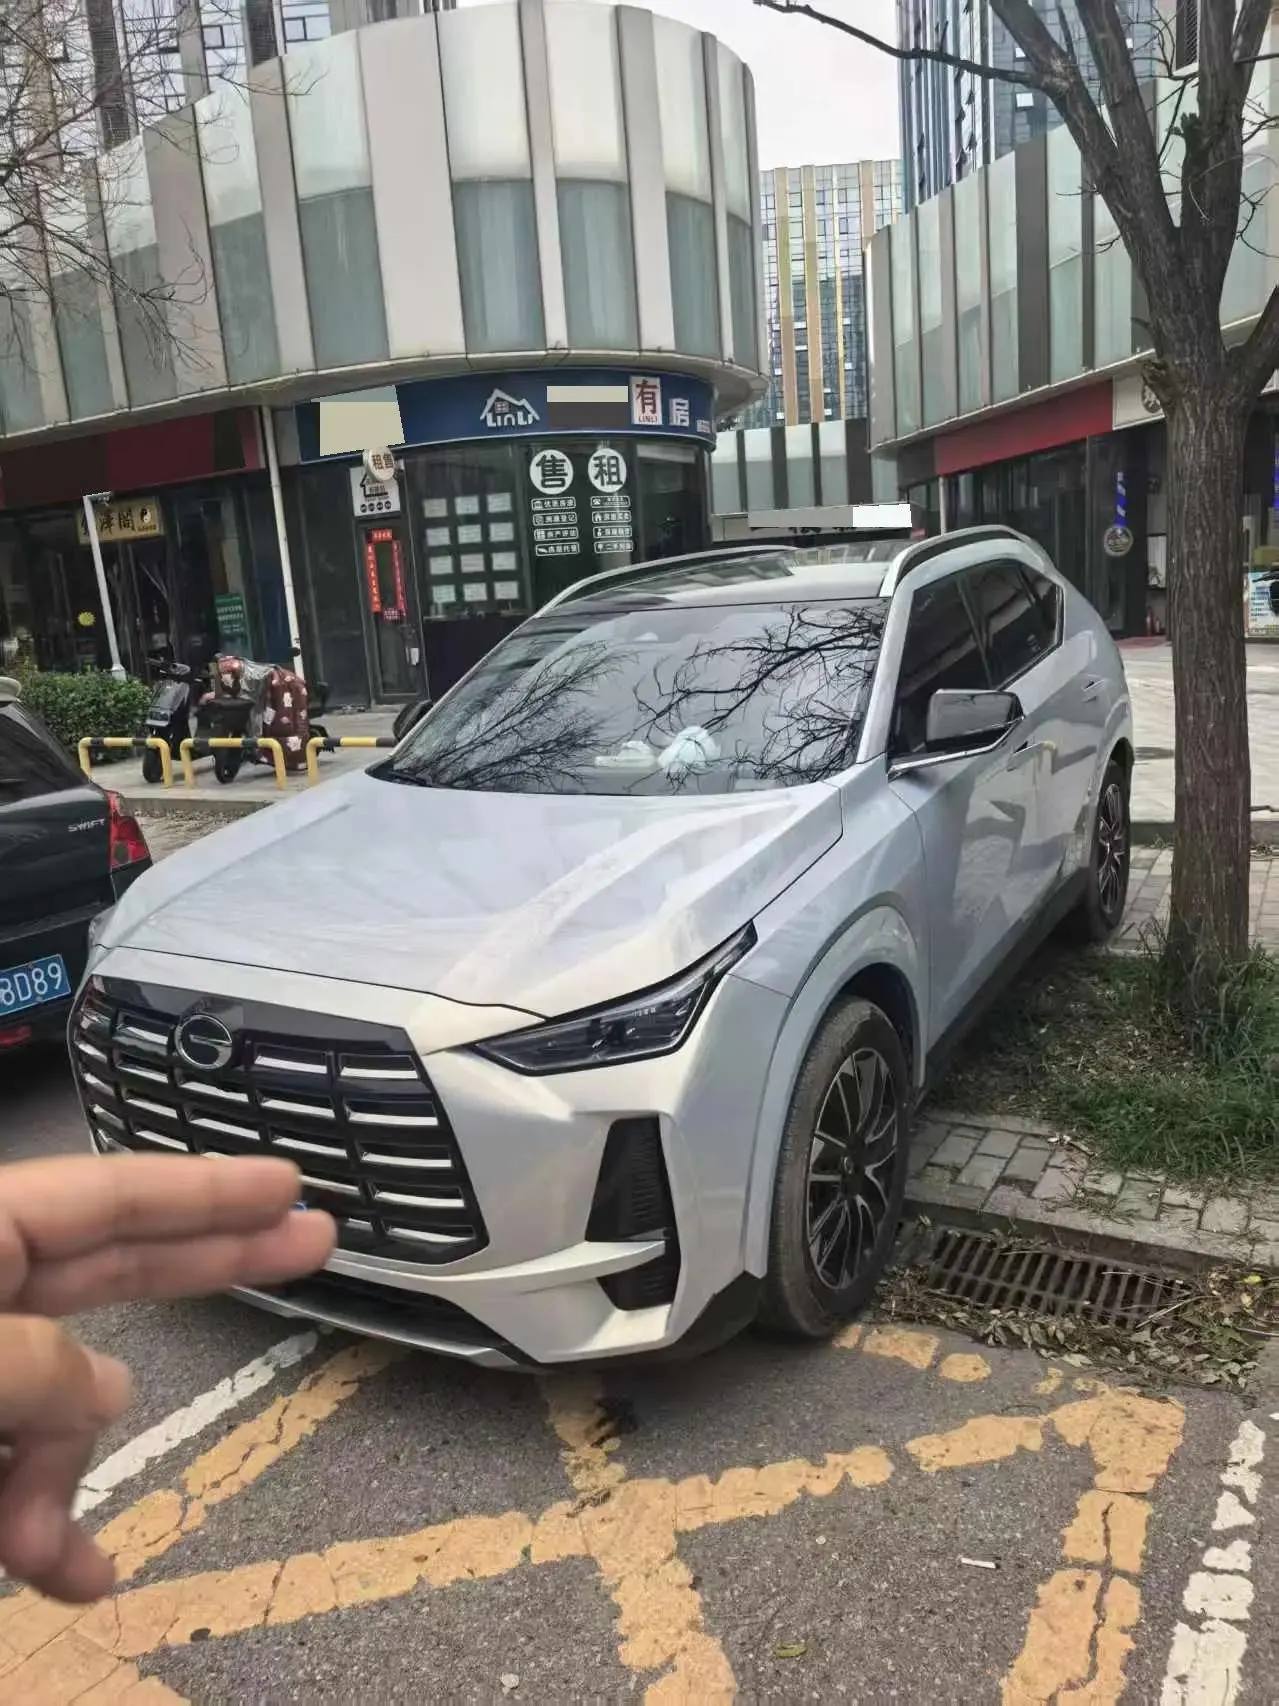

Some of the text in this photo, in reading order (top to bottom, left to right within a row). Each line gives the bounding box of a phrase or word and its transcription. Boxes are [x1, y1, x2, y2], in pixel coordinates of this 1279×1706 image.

[371, 452, 393, 471] 租售
[536, 454, 568, 488] 售
[593, 454, 623, 487] 租
[68, 818, 105, 832] SWIFT
